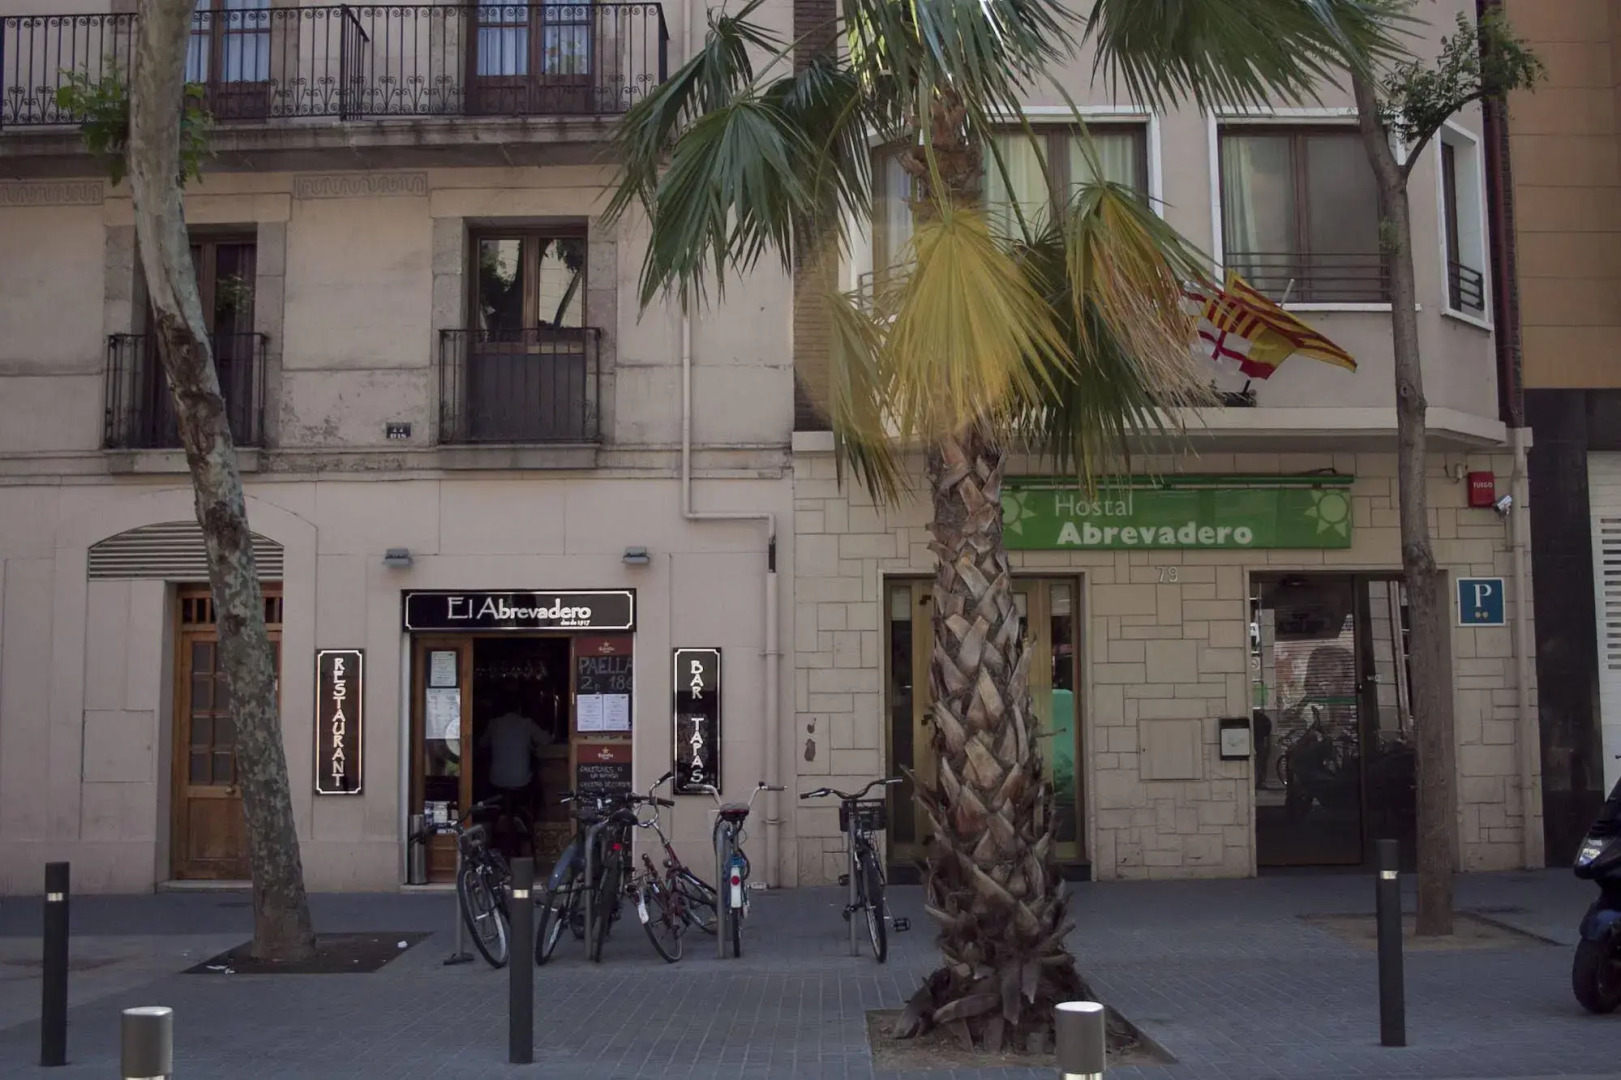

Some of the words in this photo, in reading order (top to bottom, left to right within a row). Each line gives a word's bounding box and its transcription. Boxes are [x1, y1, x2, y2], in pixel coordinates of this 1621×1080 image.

[1055, 493, 1133, 516] Hostal
[1056, 521, 1253, 545] Abrevadero
[1155, 566, 1179, 583] 79
[1473, 583, 1493, 608] P
[447, 596, 473, 620] El
[477, 596, 592, 620] Abrevadero
[579, 656, 632, 675] PAELLA
[690, 660, 704, 699] BAR
[332, 657, 346, 787] RESTAURANT
[690, 718, 704, 783] TAPAS
